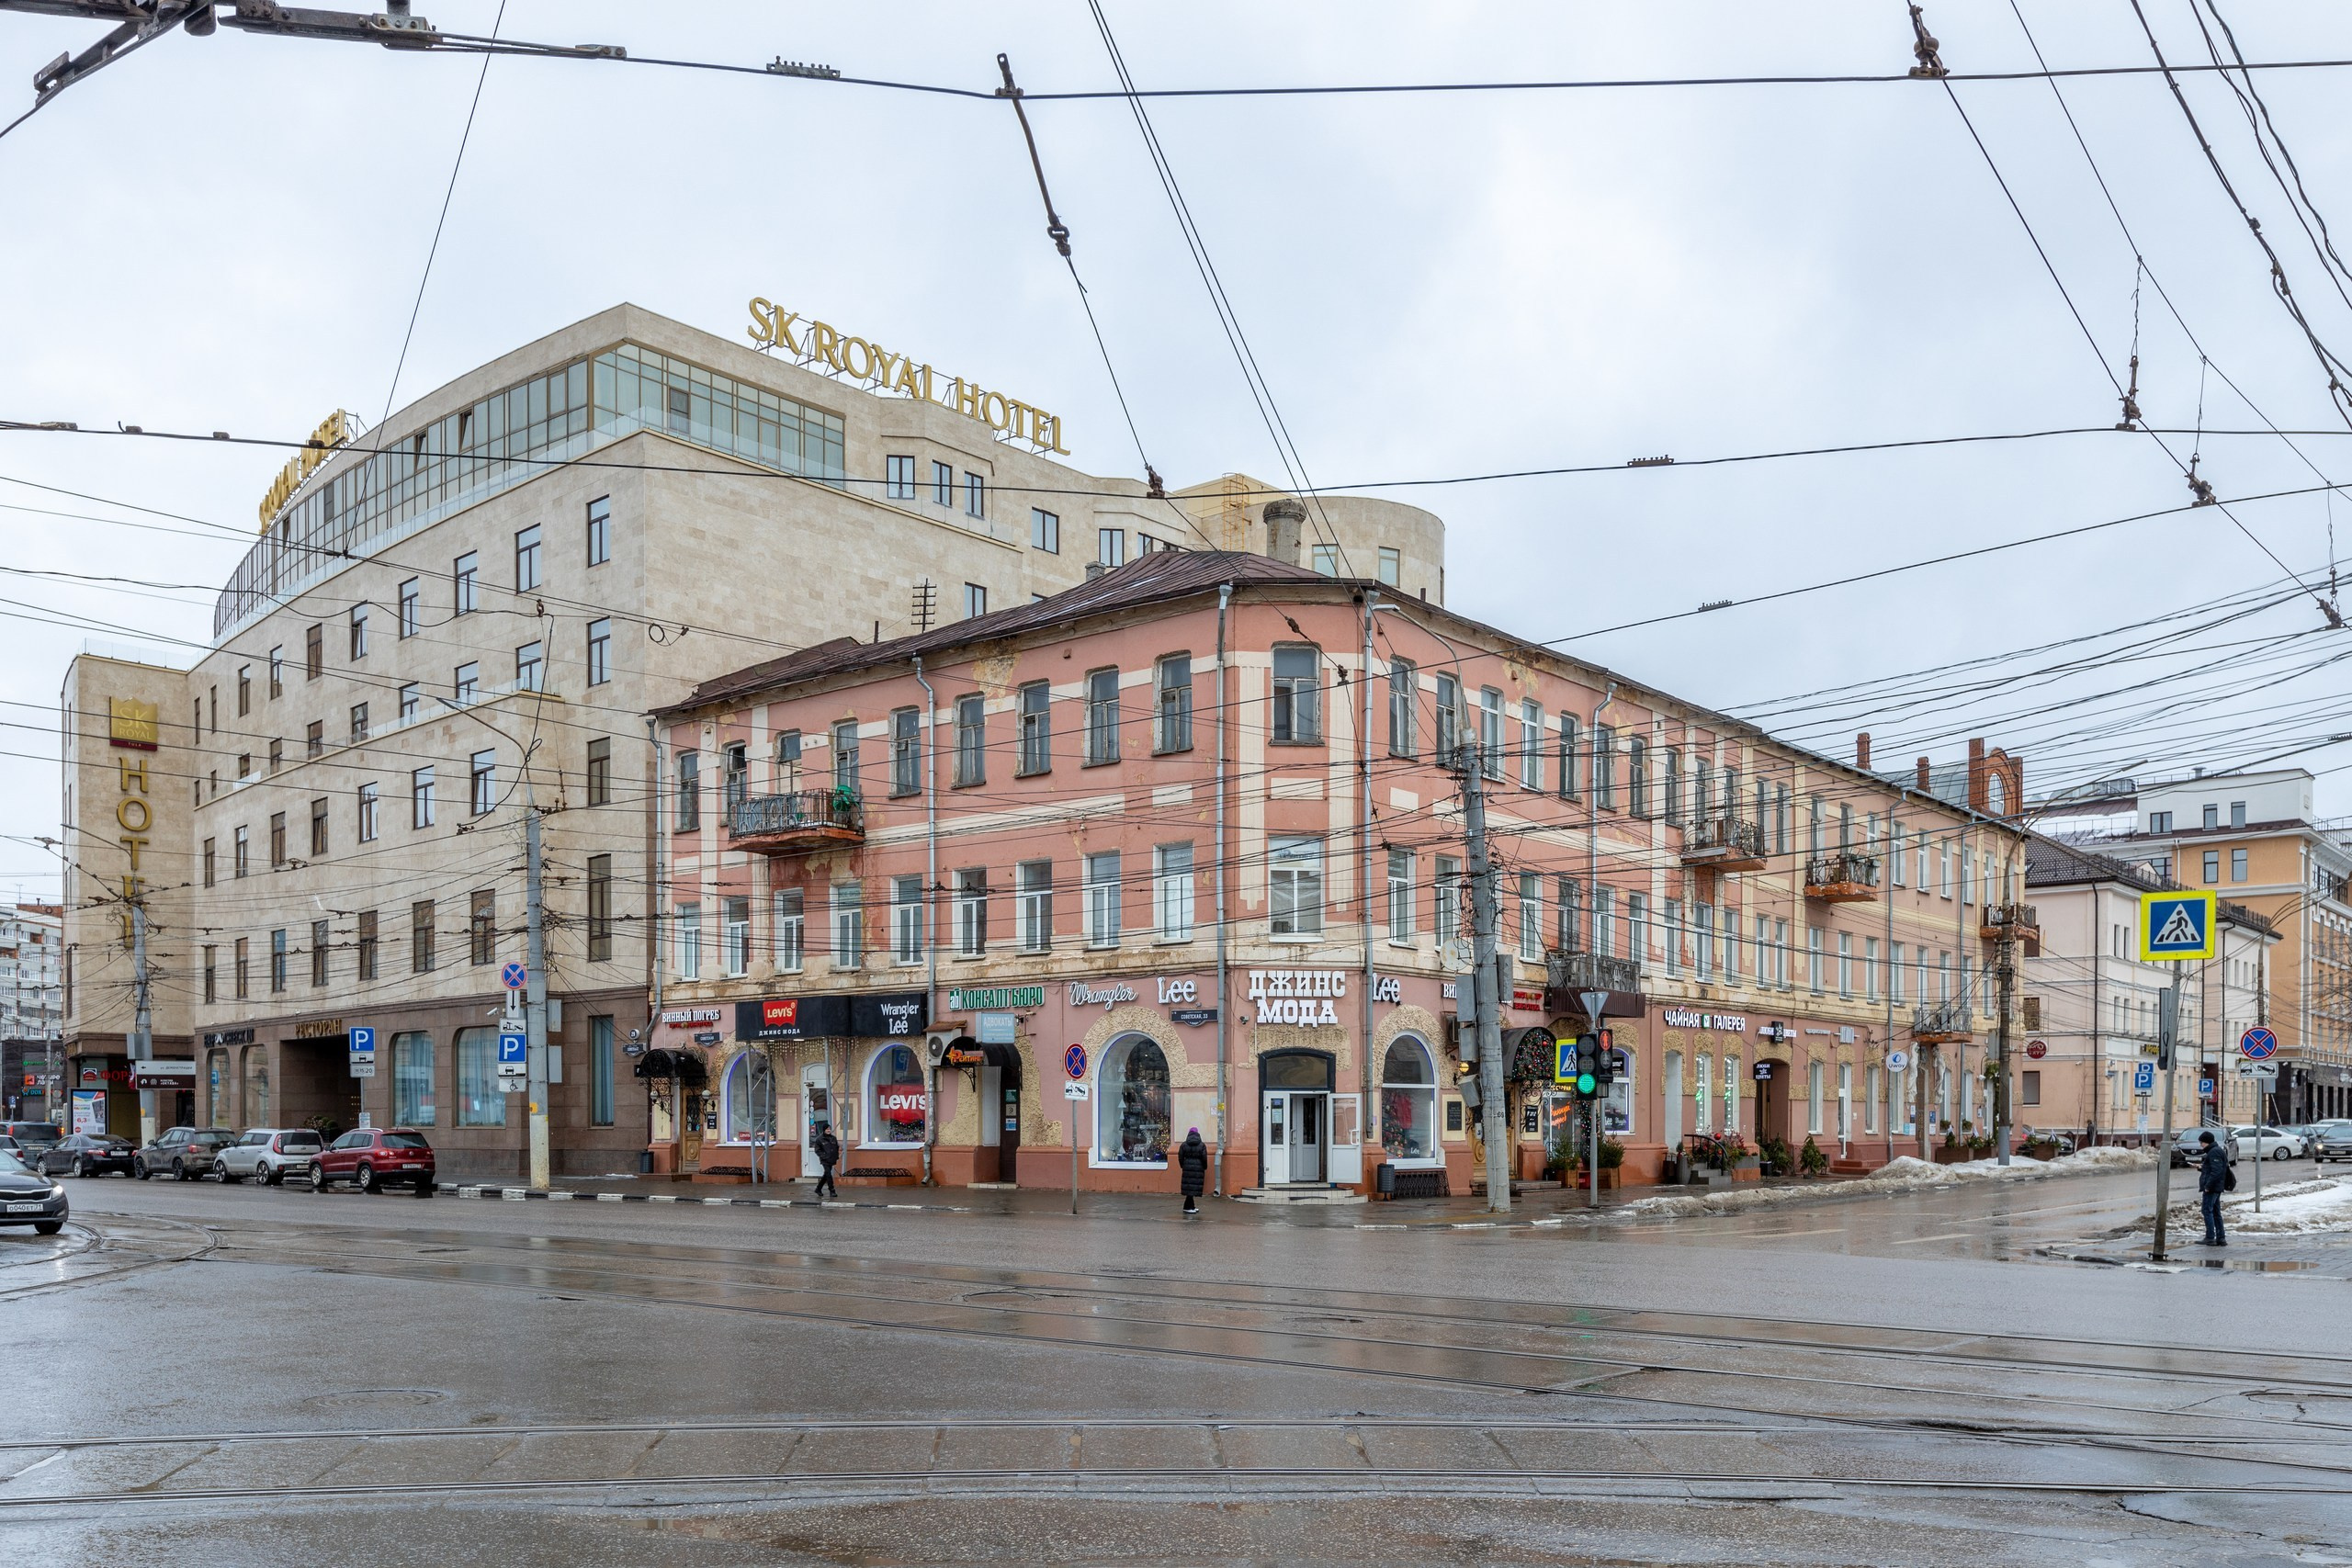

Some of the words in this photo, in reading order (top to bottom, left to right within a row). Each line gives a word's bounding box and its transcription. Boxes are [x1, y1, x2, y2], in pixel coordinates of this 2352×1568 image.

[747, 297, 801, 355] SK
[813, 321, 943, 405] ROYAL
[955, 376, 1070, 457] HOTEL
[119, 706, 150, 730] SK
[119, 728, 153, 740] ROYAL
[1069, 981, 1138, 1010] Wrangler
[1157, 976, 1197, 1004] Lee
[1249, 970, 1346, 1000] ДЖИНС
[1373, 972, 1400, 1002] Lee
[962, 988, 1010, 1009] КОНСАЛТ
[1012, 987, 1044, 1007] БЮРО
[662, 1009, 692, 1022] ВИННЫЙ
[693, 1010, 719, 1021] ПОГРЕБ
[880, 1001, 919, 1020] Wrangler
[1257, 999, 1338, 1028] МОДА
[1665, 1008, 1700, 1028] ЧАЙНАЯ
[1713, 1014, 1746, 1032] ГАЛЕРЕЯ
[295, 1019, 343, 1037] РЕСТОРАН
[888, 1019, 908, 1034] Lee
[984, 1017, 1012, 1028] АДВОКАТЫ
[355, 1030, 369, 1049] P
[503, 1037, 519, 1059] P
[2138, 1074, 2149, 1088] P
[2201, 1081, 2211, 1091] P
